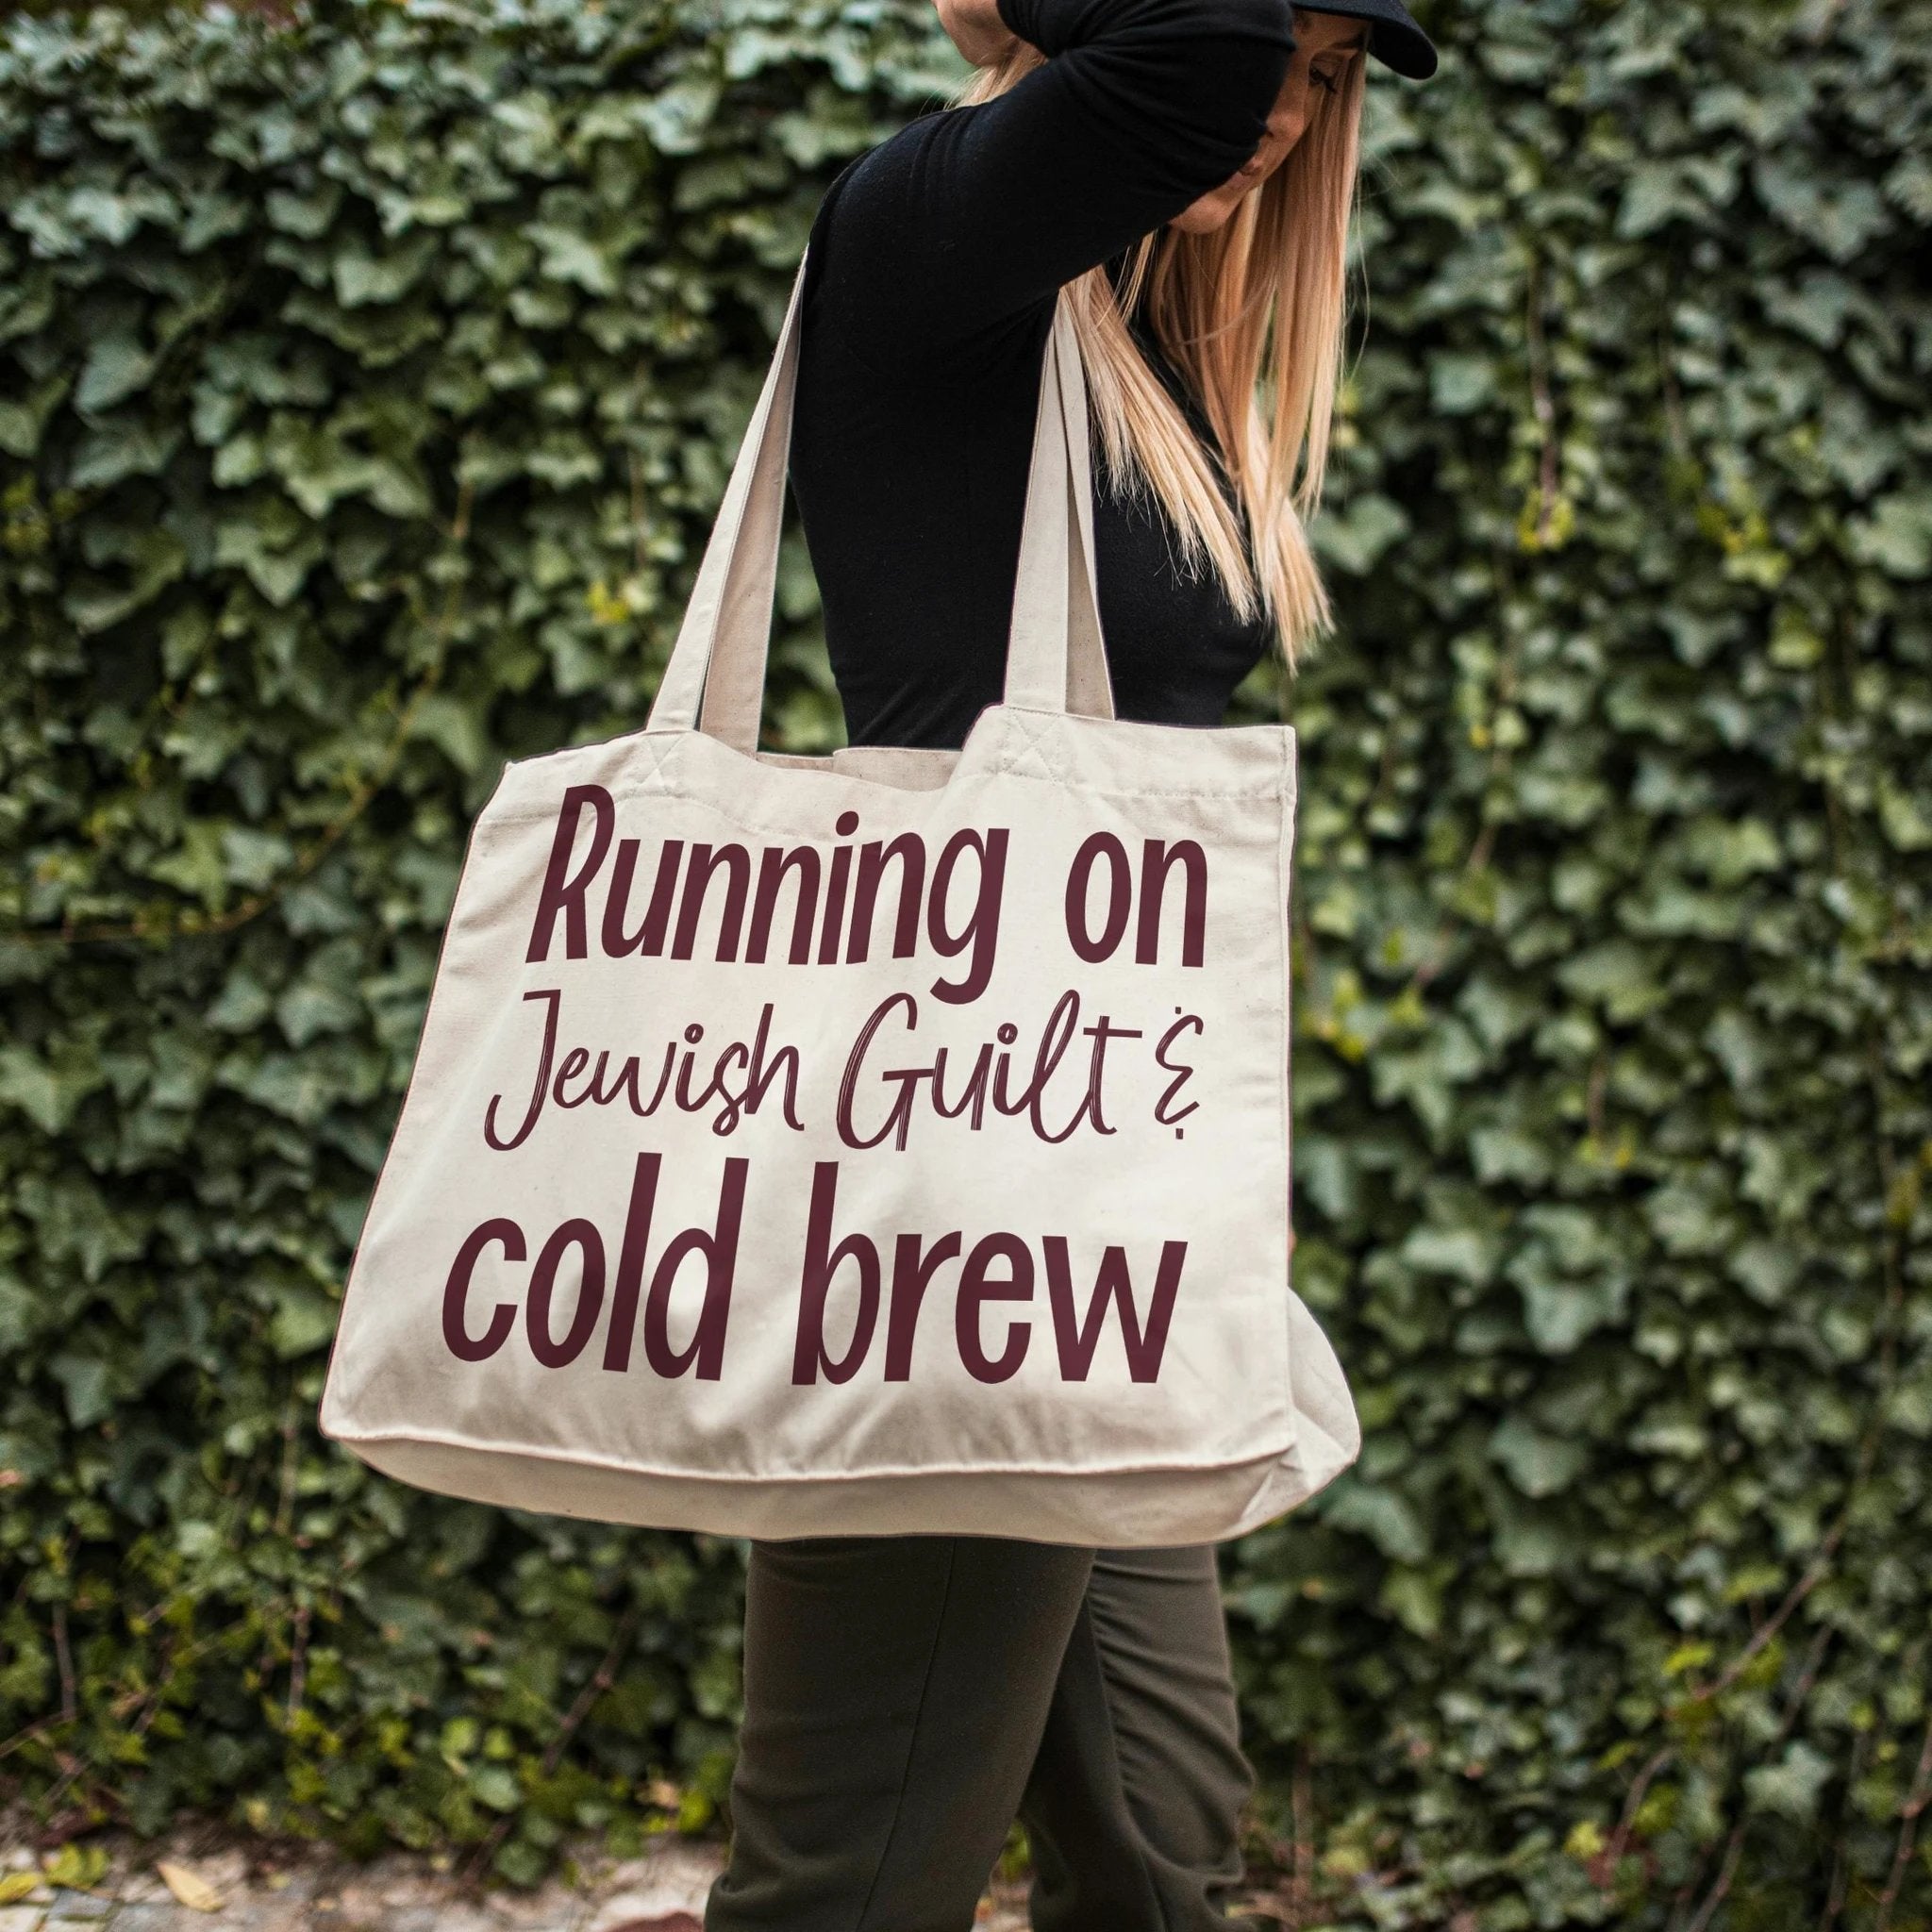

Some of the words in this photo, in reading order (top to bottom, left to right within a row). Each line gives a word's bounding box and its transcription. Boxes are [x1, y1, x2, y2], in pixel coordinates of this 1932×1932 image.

[525, 784, 1010, 1005] Running
[1065, 831, 1208, 968] on
[484, 989, 805, 1151] Jewish
[836, 989, 1143, 1152] Guilt
[1154, 1006, 1204, 1140] &
[441, 1152, 749, 1381] cold
[791, 1161, 1189, 1386] brew
